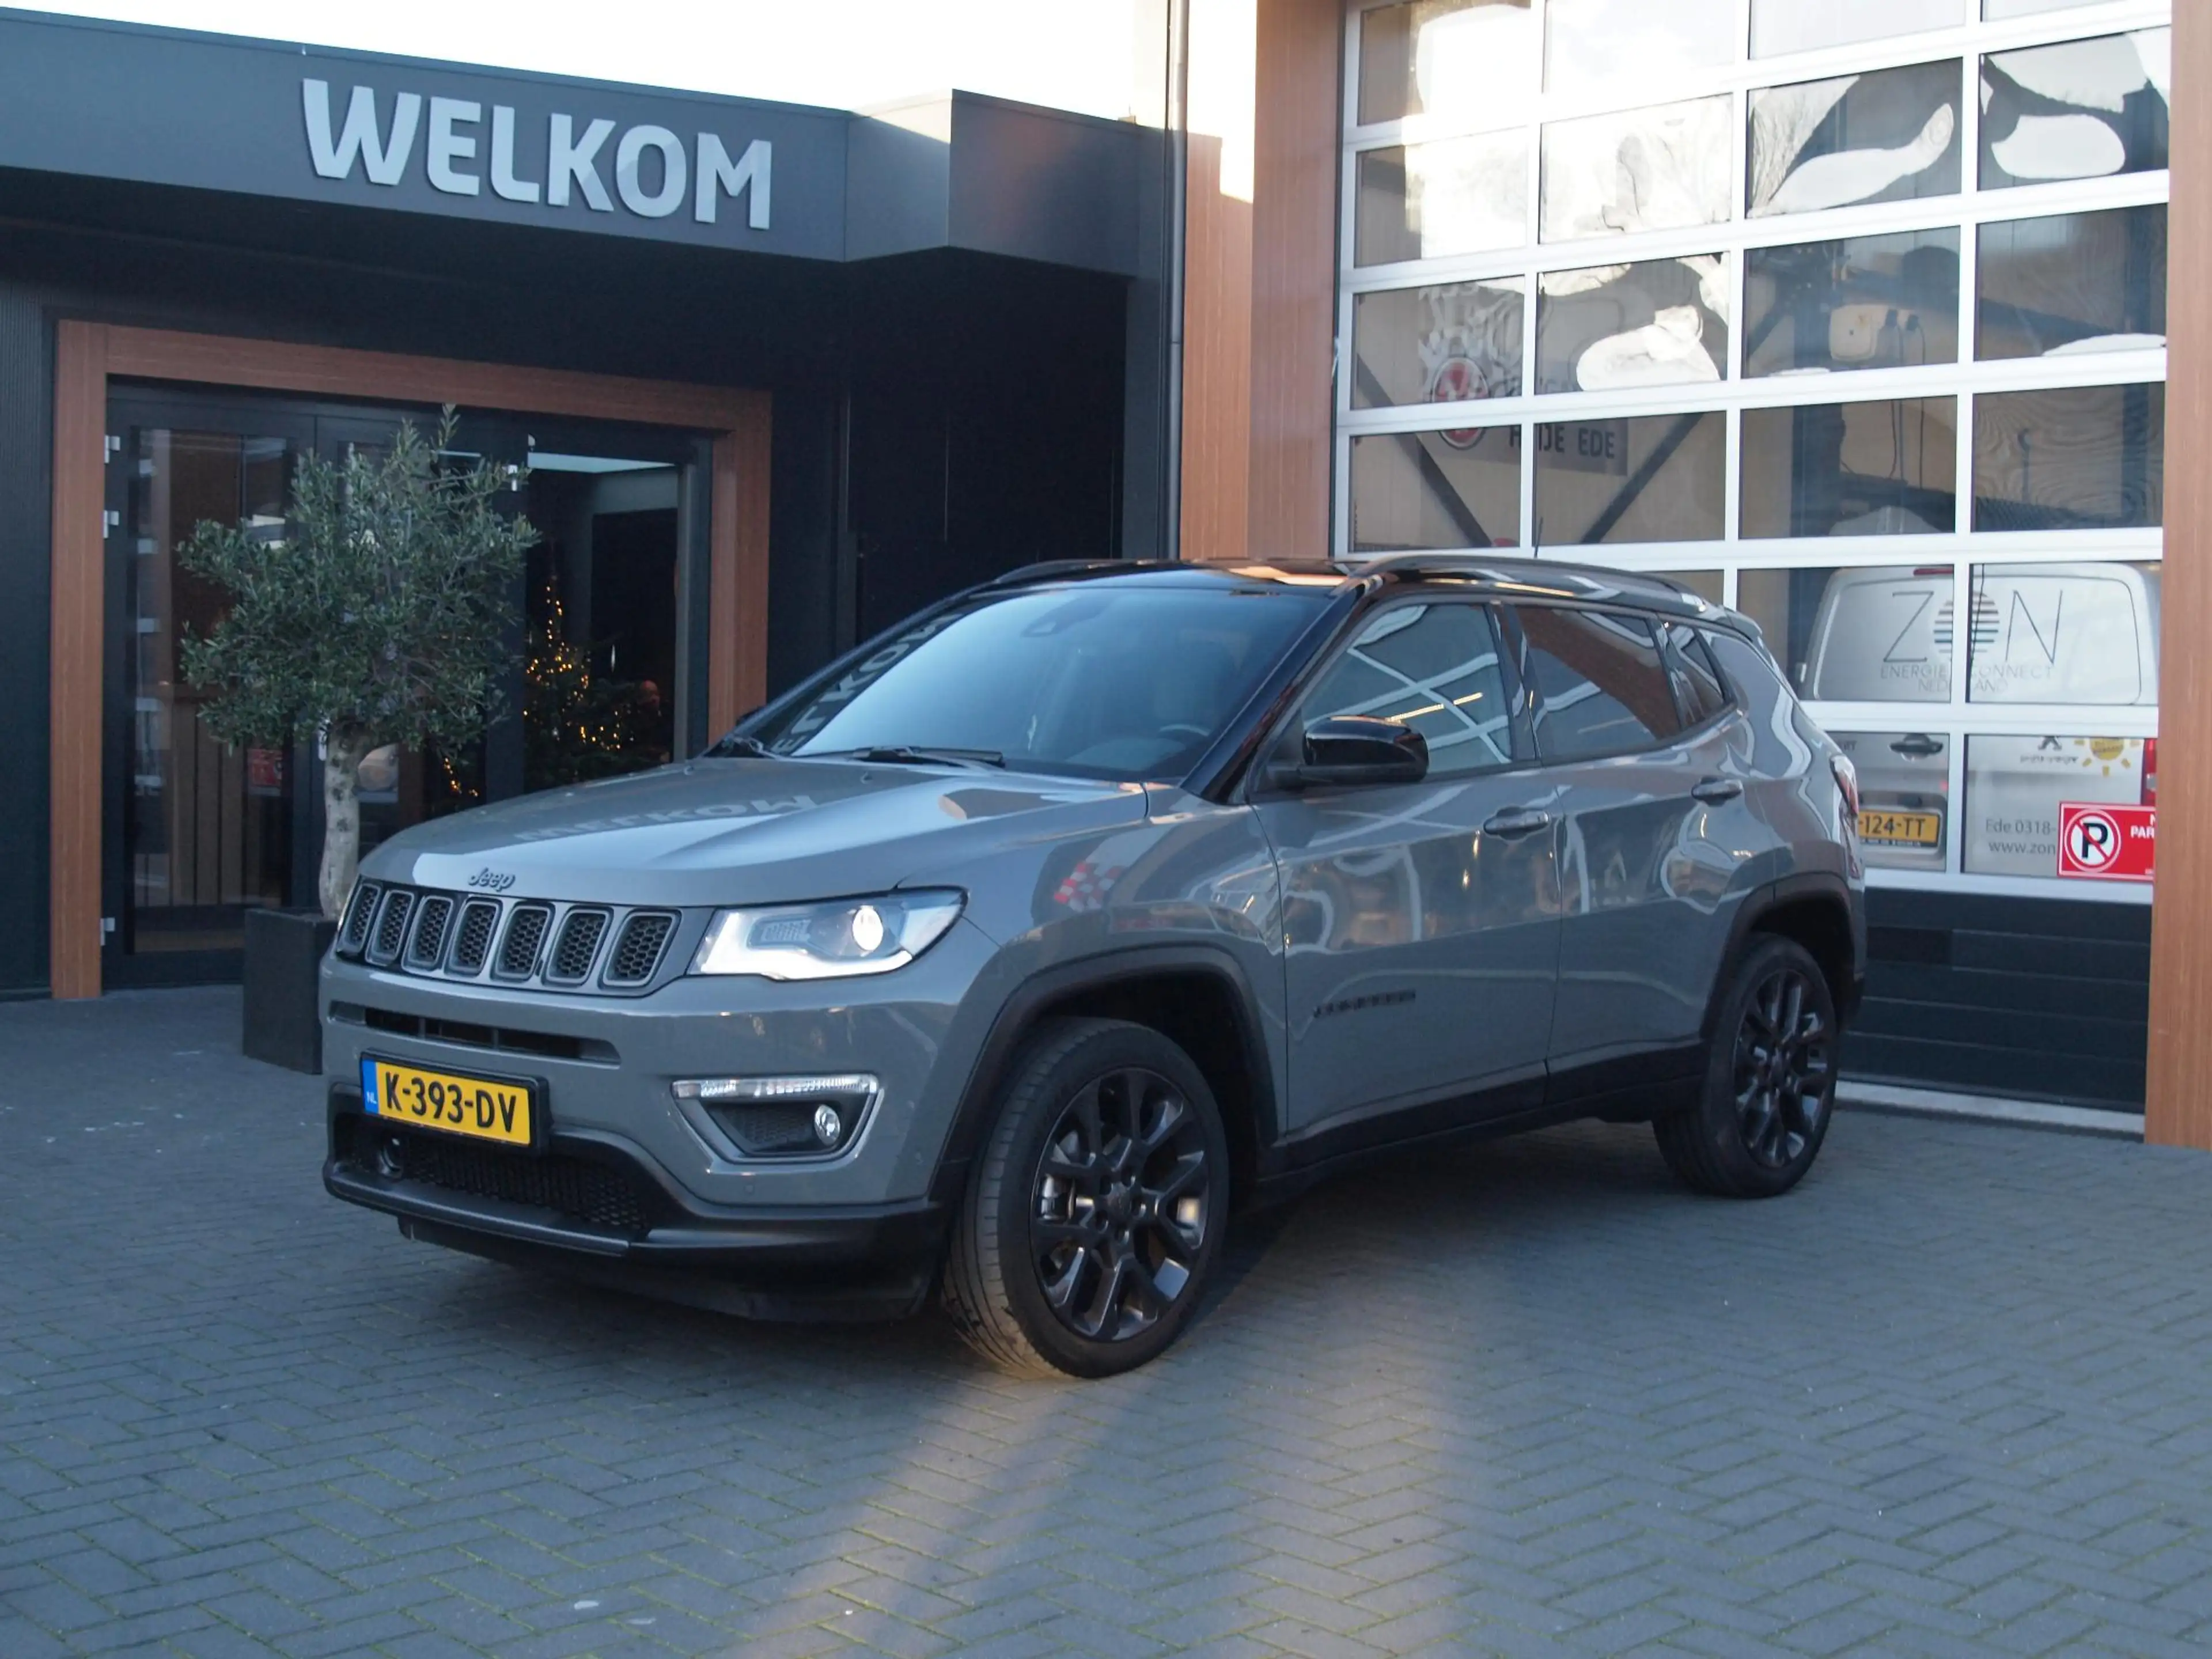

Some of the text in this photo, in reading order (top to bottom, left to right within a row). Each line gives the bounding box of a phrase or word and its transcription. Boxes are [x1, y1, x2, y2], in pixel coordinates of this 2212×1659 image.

[302, 78, 773, 230] WELKOM
[1578, 427, 1616, 459] EDE
[1986, 818, 2012, 833] Ede
[467, 866, 516, 892] Jeep
[385, 1071, 517, 1134] K-393-DV
